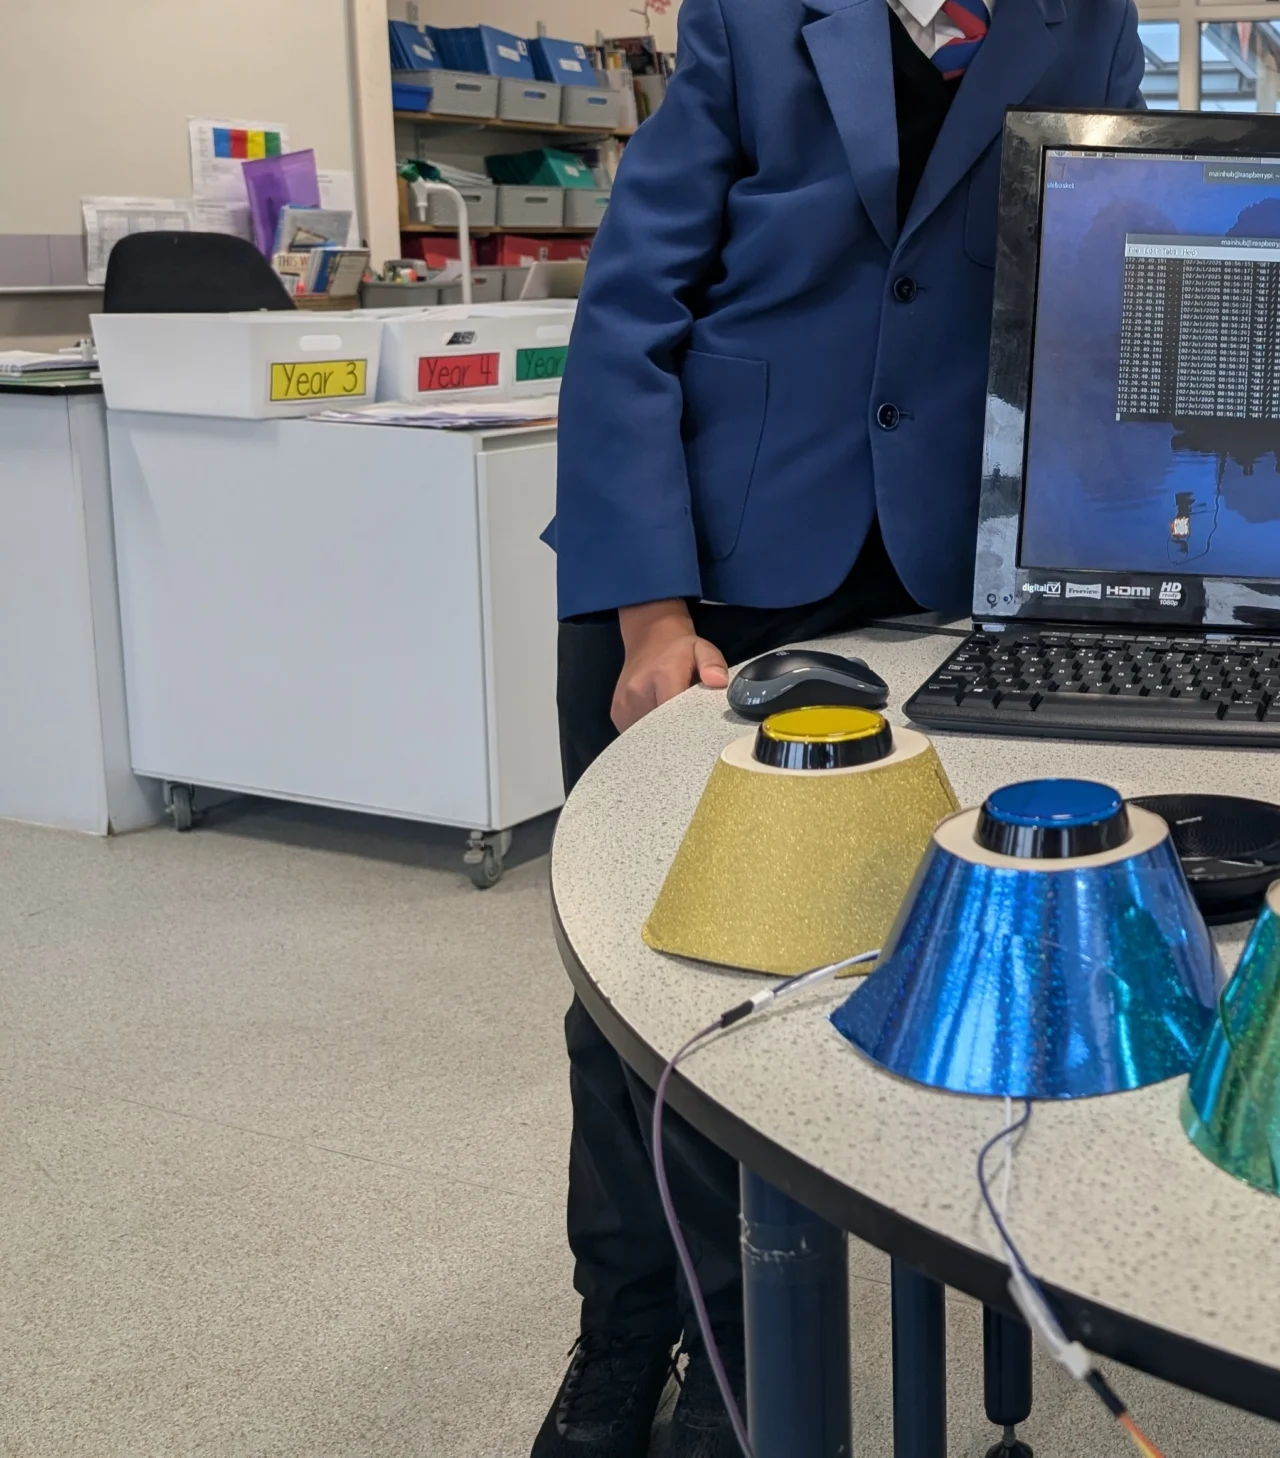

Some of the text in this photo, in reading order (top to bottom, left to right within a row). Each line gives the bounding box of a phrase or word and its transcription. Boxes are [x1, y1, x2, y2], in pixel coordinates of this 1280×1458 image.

[426, 354, 492, 390] Year 4
[281, 361, 358, 397] Year 3
[1022, 583, 1047, 594] digital
[1068, 586, 1099, 595] Freeview
[1106, 585, 1151, 596] HDMI
[1160, 582, 1182, 592] HD
